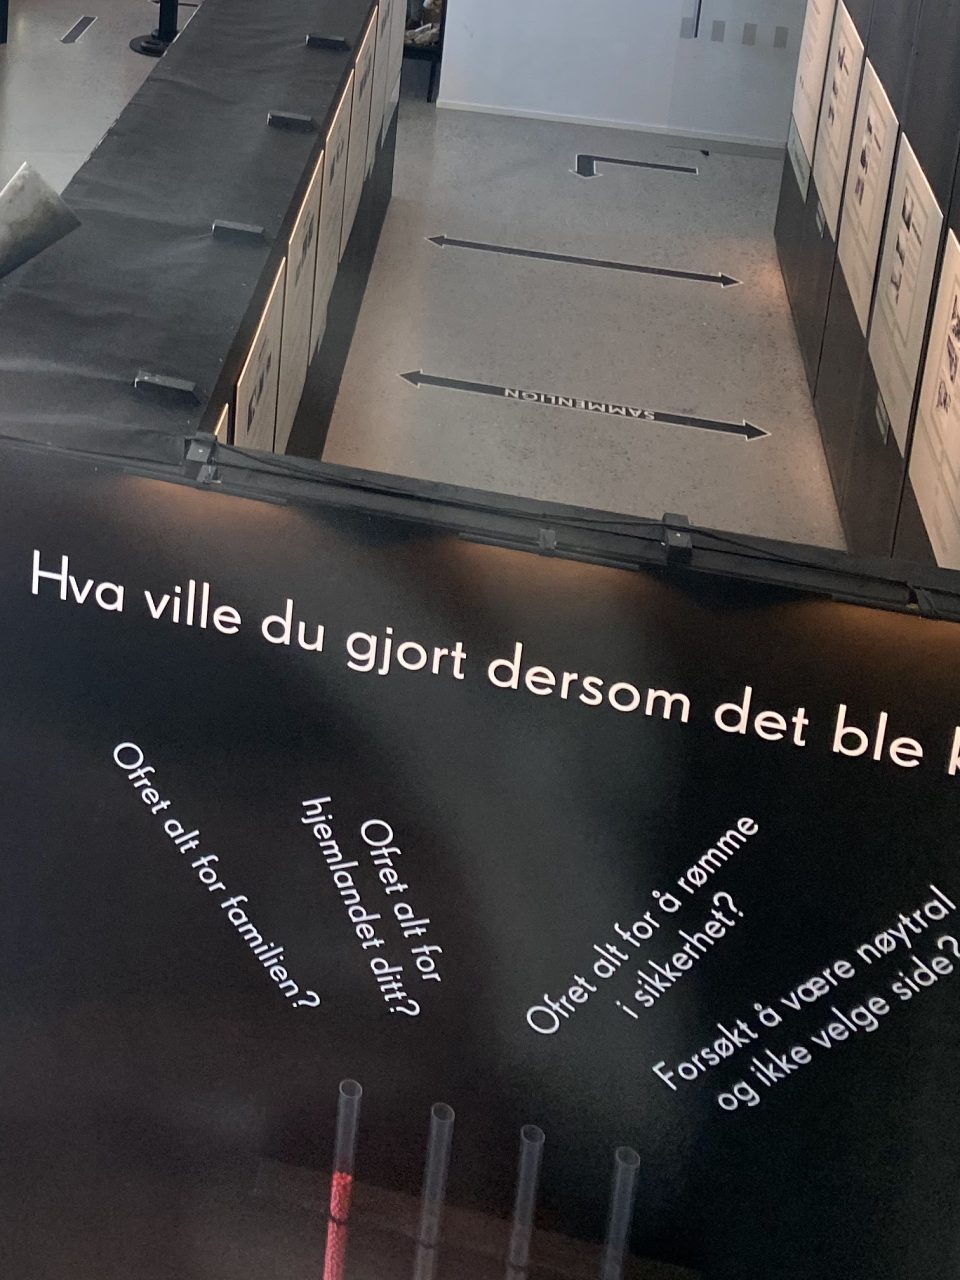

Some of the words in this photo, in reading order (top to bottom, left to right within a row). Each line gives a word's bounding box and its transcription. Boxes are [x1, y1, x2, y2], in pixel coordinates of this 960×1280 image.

[504, 387, 655, 420] SAMMENLIGN
[31, 549, 125, 612] Hva
[143, 578, 242, 635] ville
[261, 598, 325, 652] du
[345, 626, 467, 680] gjort
[487, 641, 691, 723] dersom
[714, 685, 809, 747] det
[832, 703, 924, 768] ble
[113, 742, 171, 815] Ofret
[163, 819, 200, 854] alt
[191, 854, 226, 892] for
[220, 895, 321, 1008] familien?
[300, 796, 385, 950] hjemlandet
[370, 957, 421, 1016] ditt?
[360, 818, 409, 895] Ofret
[393, 902, 431, 938] alt
[411, 944, 443, 982] for
[526, 974, 598, 1034] Ofret
[593, 942, 629, 979] alt
[613, 911, 660, 948] for
[651, 890, 682, 913] å
[677, 817, 759, 894] rømme
[616, 999, 639, 1019] i
[634, 891, 744, 1008] sikkerhet?
[651, 1019, 759, 1091] Forsøkt
[753, 1002, 783, 1027] å
[780, 960, 855, 1010] være
[856, 884, 957, 964] nøytral
[718, 1081, 761, 1111] og
[752, 1046, 812, 1087] ikke
[811, 997, 890, 1048] velge
